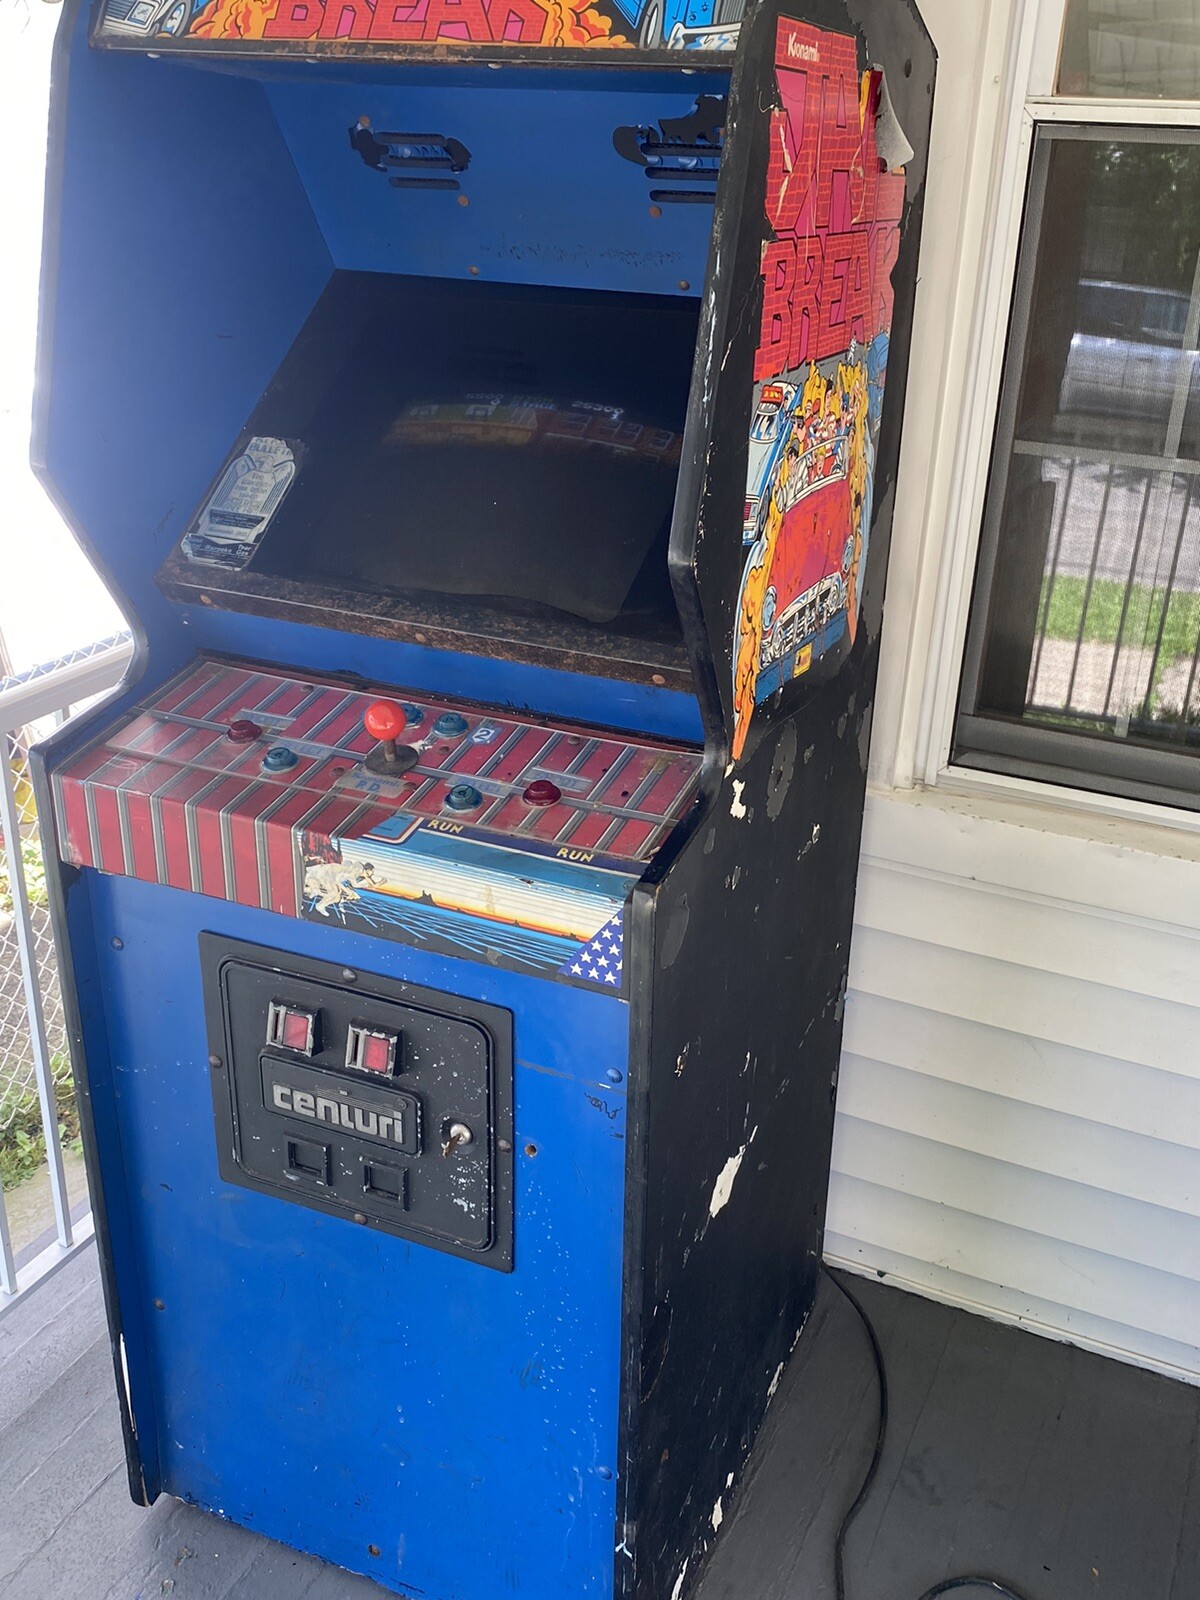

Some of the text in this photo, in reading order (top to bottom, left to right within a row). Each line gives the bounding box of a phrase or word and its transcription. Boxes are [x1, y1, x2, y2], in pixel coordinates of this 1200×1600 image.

[788, 32, 819, 62] Konami
[753, 225, 900, 382] BREAK
[474, 729, 490, 741] 2
[428, 819, 464, 834] RUN
[556, 847, 595, 863] RUN
